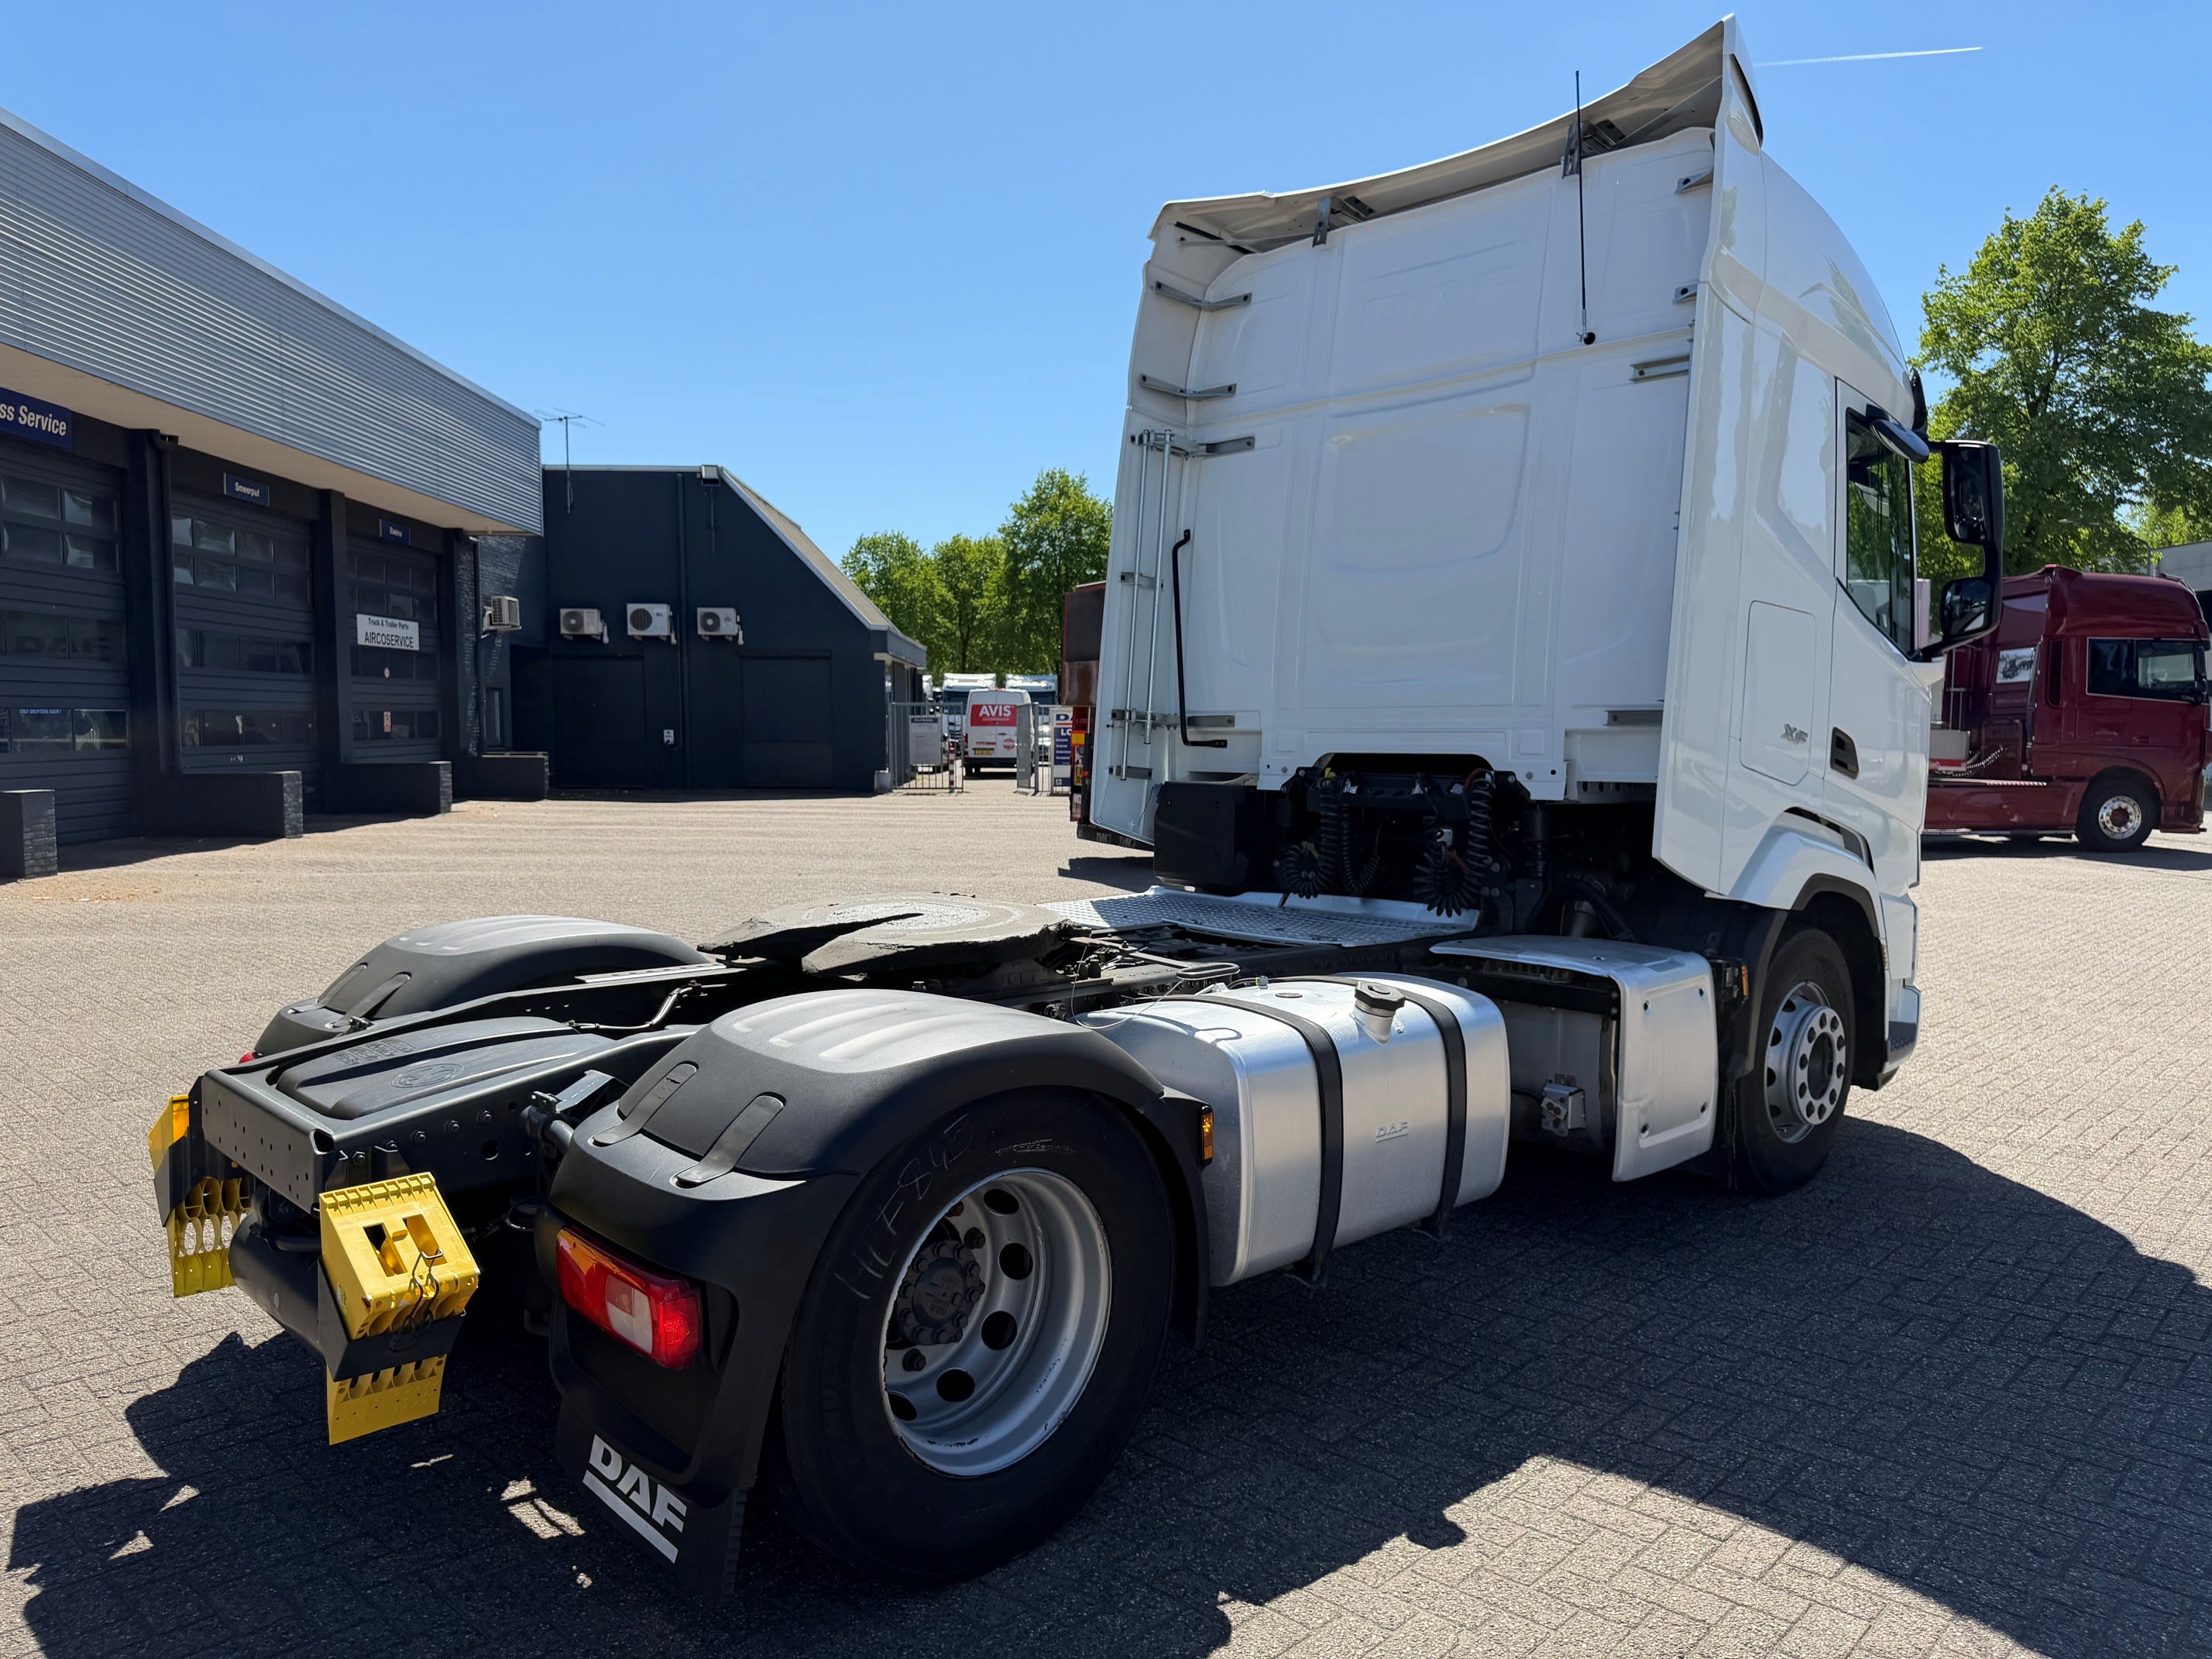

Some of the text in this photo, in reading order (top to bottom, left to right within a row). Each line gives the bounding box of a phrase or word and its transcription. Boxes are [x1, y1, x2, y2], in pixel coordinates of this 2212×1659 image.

[19, 405, 67, 436] Service
[368, 617, 380, 627] Truck
[365, 631, 414, 648] AIRCOSERVICE
[979, 705, 1012, 716] AVIS
[1376, 1121, 1408, 1138] DAF
[589, 1434, 687, 1534] DAF
